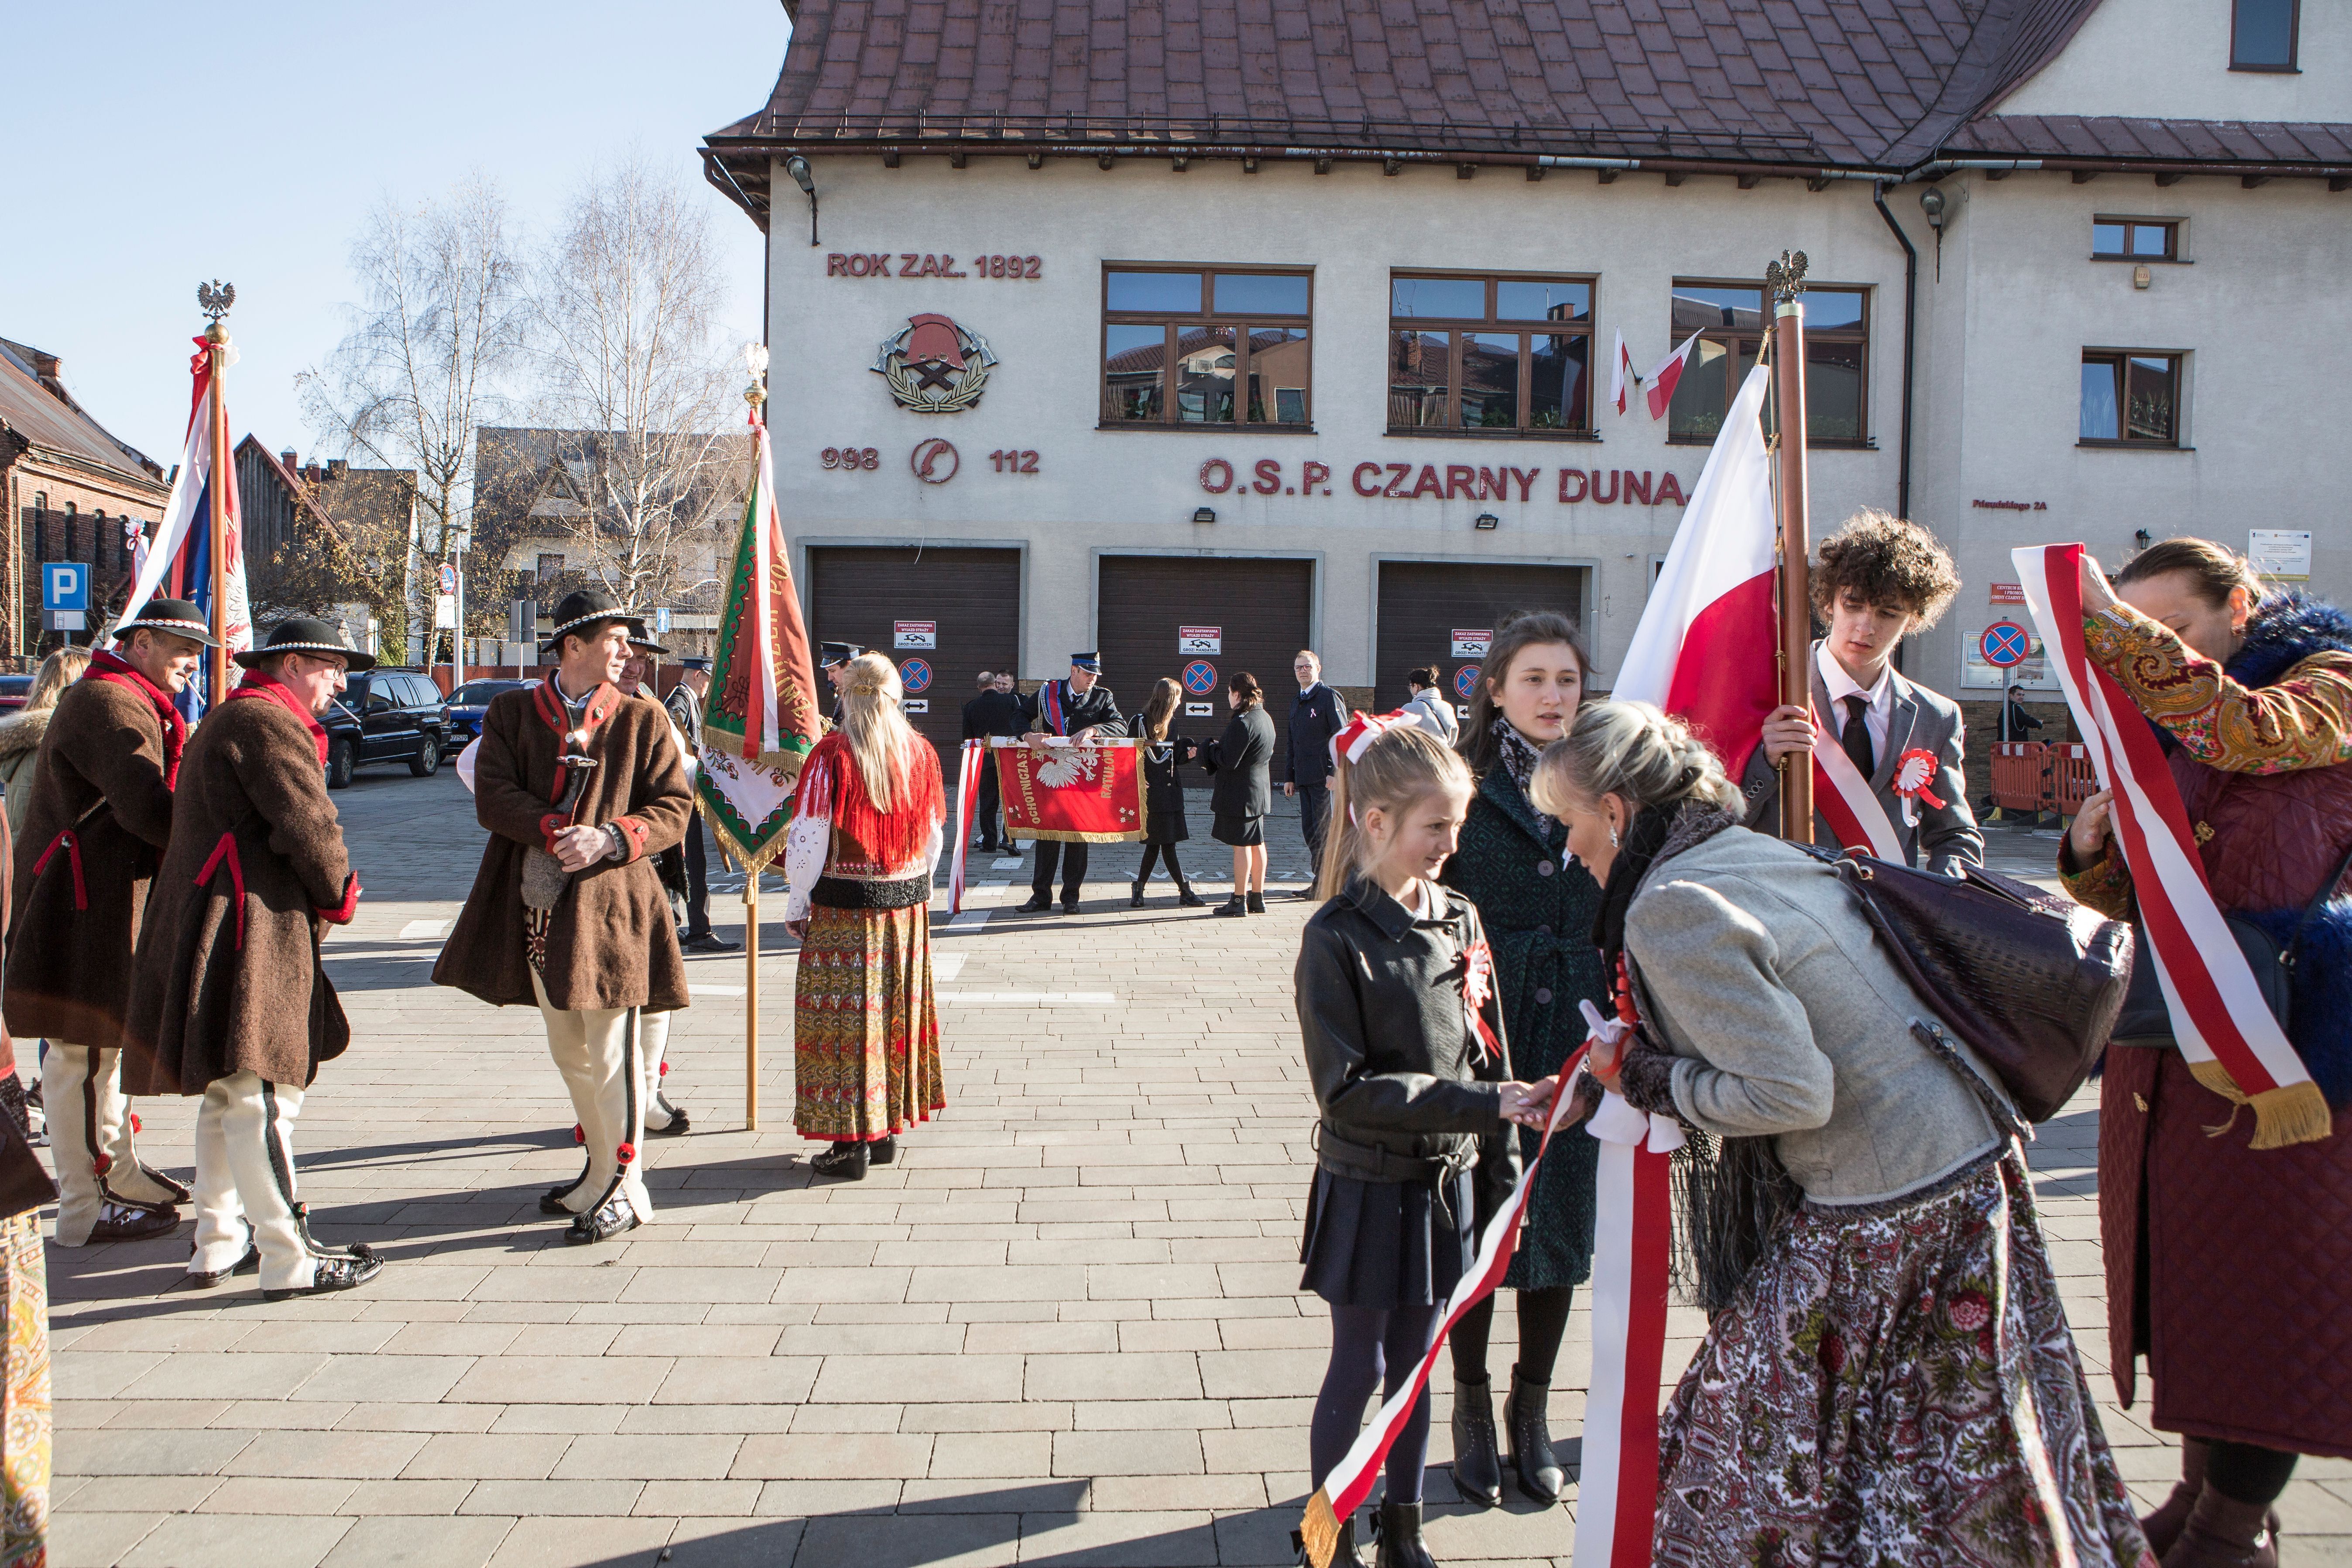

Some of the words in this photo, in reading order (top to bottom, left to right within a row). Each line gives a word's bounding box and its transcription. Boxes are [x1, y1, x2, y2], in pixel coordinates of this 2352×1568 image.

[828, 253, 891, 276] ROK
[899, 254, 966, 278] ZAŁ.
[974, 255, 1040, 278] 1892
[821, 447, 878, 470] 998
[990, 449, 1039, 472] 112
[1200, 458, 1331, 495] O.S.P.
[1353, 461, 1540, 501] CZARNY
[1559, 468, 1690, 506] DUNA
[2033, 501, 2047, 510] 2A
[53, 568, 77, 604] P
[1101, 749, 1115, 799] RATUŁÓW
[1017, 760, 1041, 824] OCHOTNICZA
